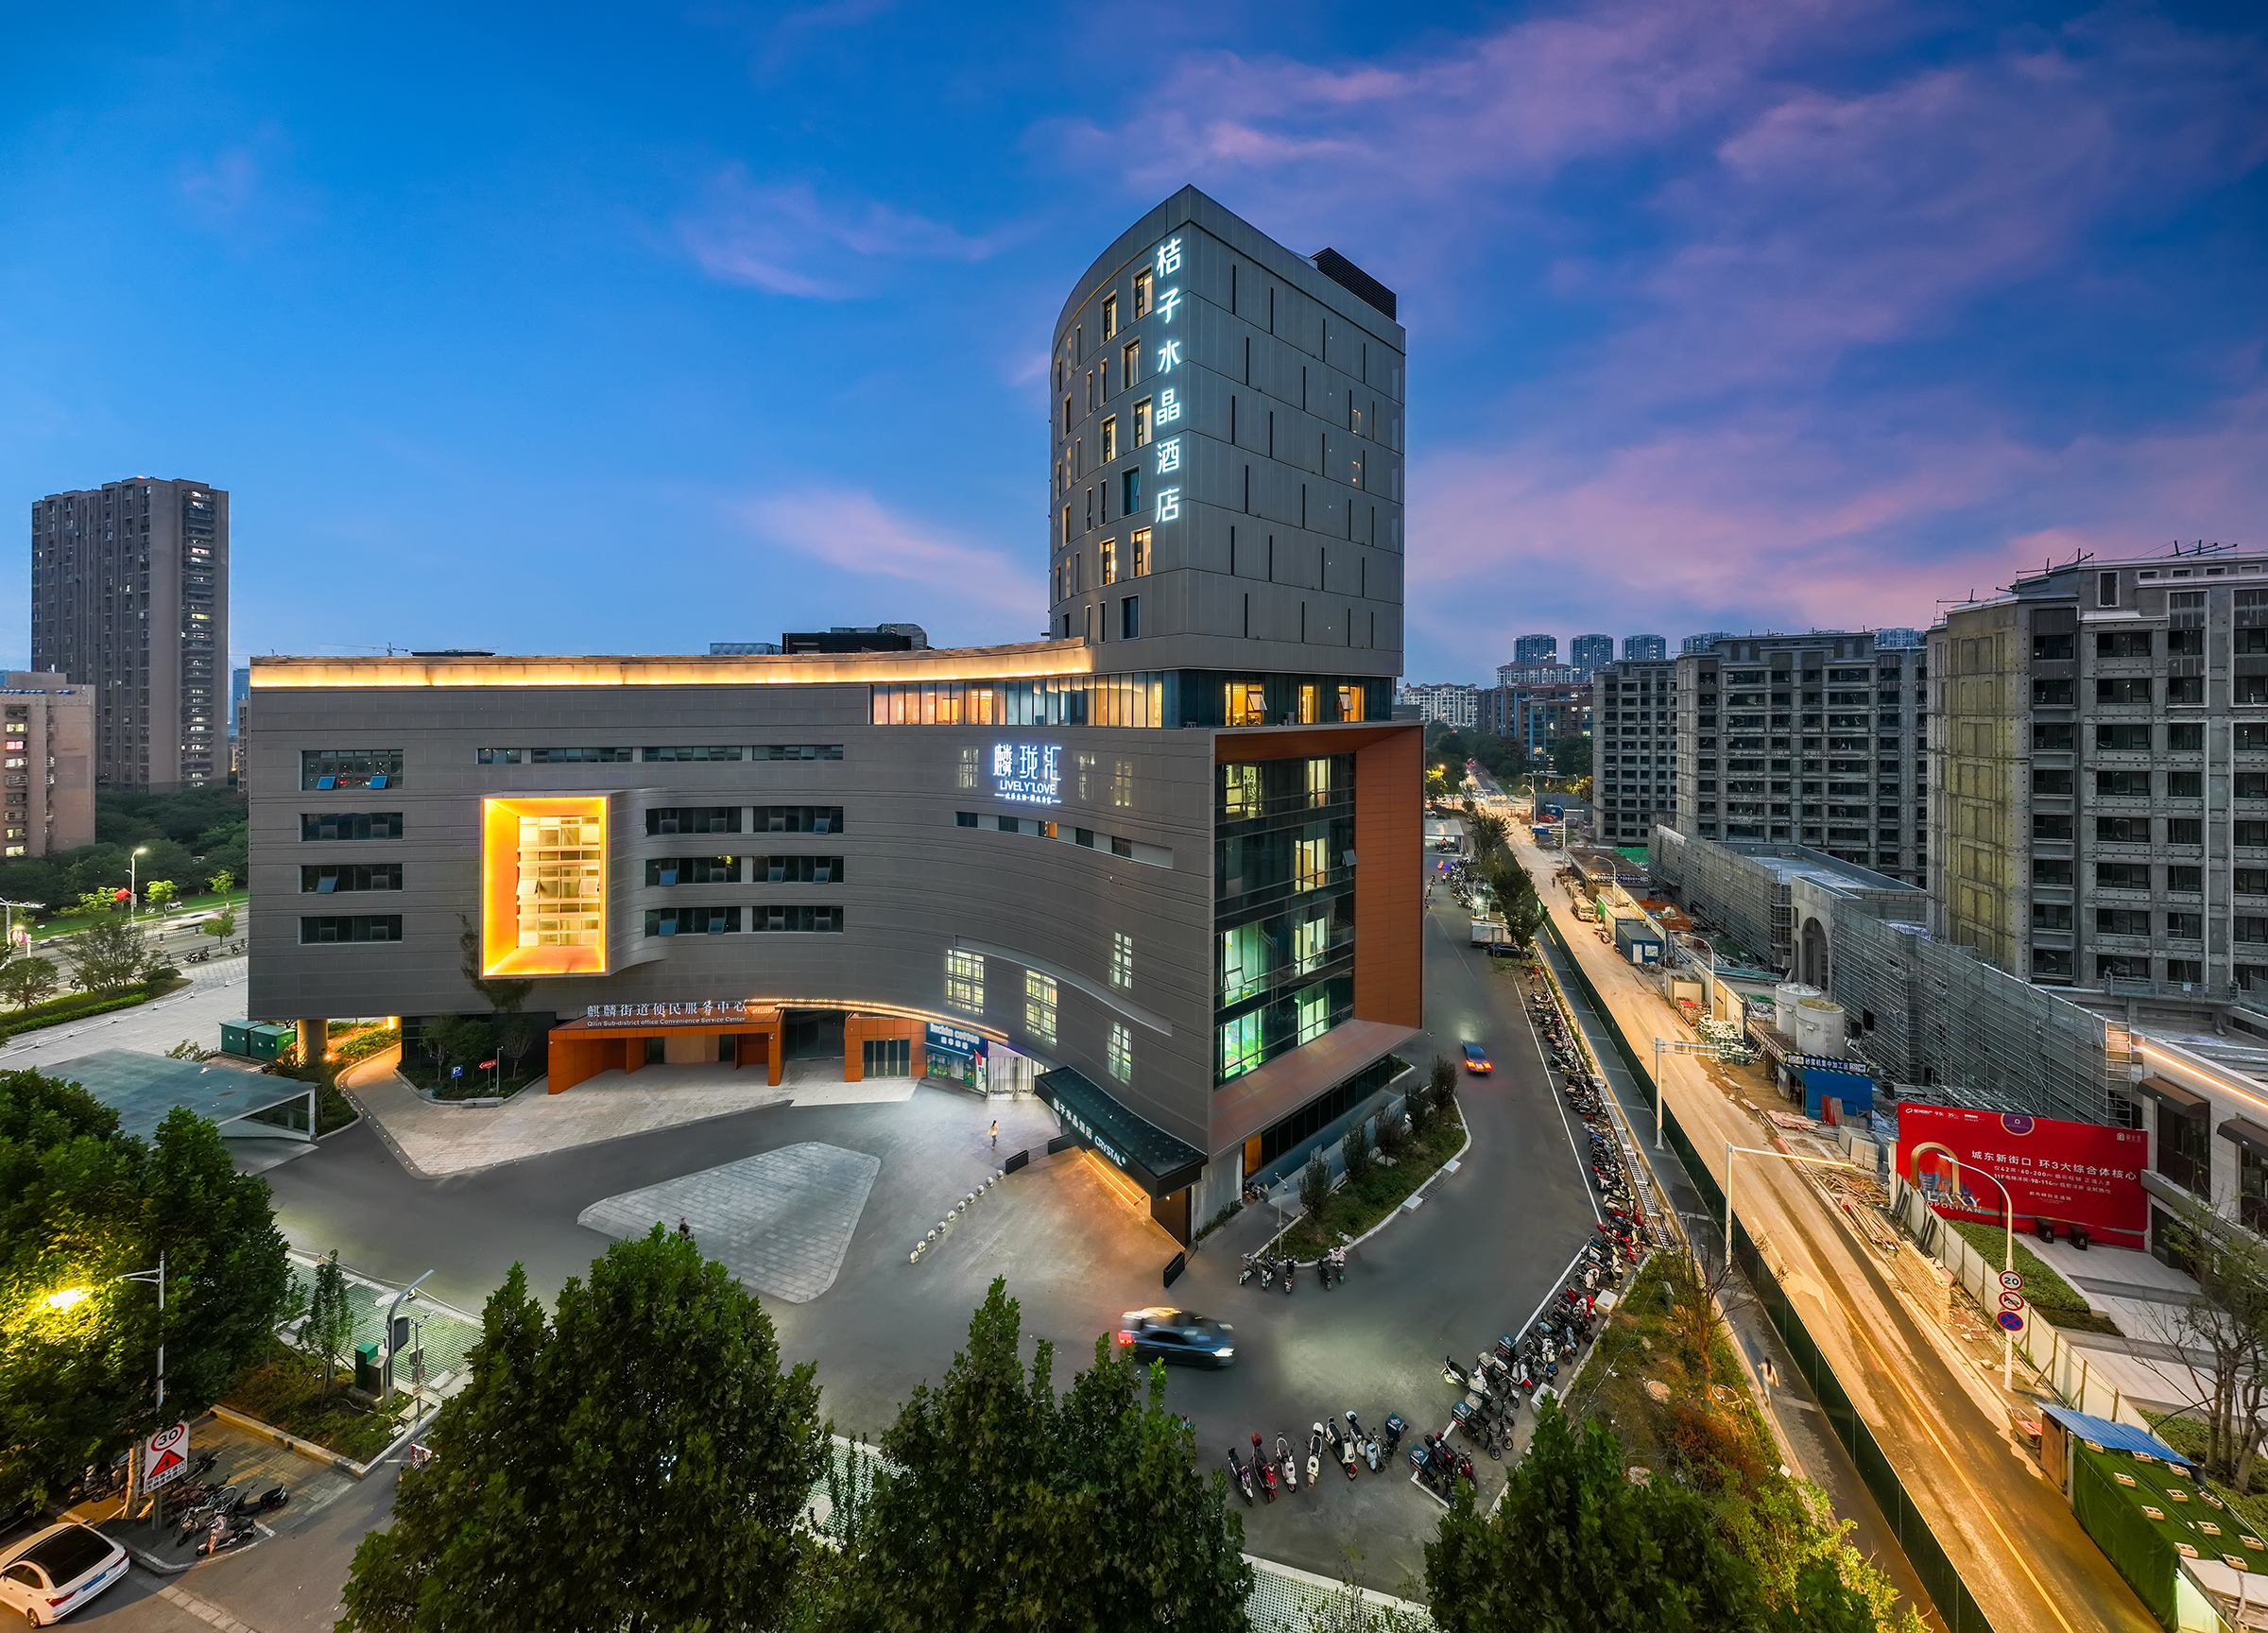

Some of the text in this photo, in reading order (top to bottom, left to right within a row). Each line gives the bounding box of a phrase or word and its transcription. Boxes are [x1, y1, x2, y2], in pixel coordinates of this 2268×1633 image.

[1156, 238, 1181, 523] 桔子水晶酒店
[587, 1002, 746, 1018] 麒麟街道便民服务中心
[1971, 1150, 2137, 1180] 城东新街口 环3大综合体核心
[1926, 1201, 1982, 1213] OPOLITAN
[2004, 1277, 2019, 1285] 20
[158, 1429, 179, 1446] 30
